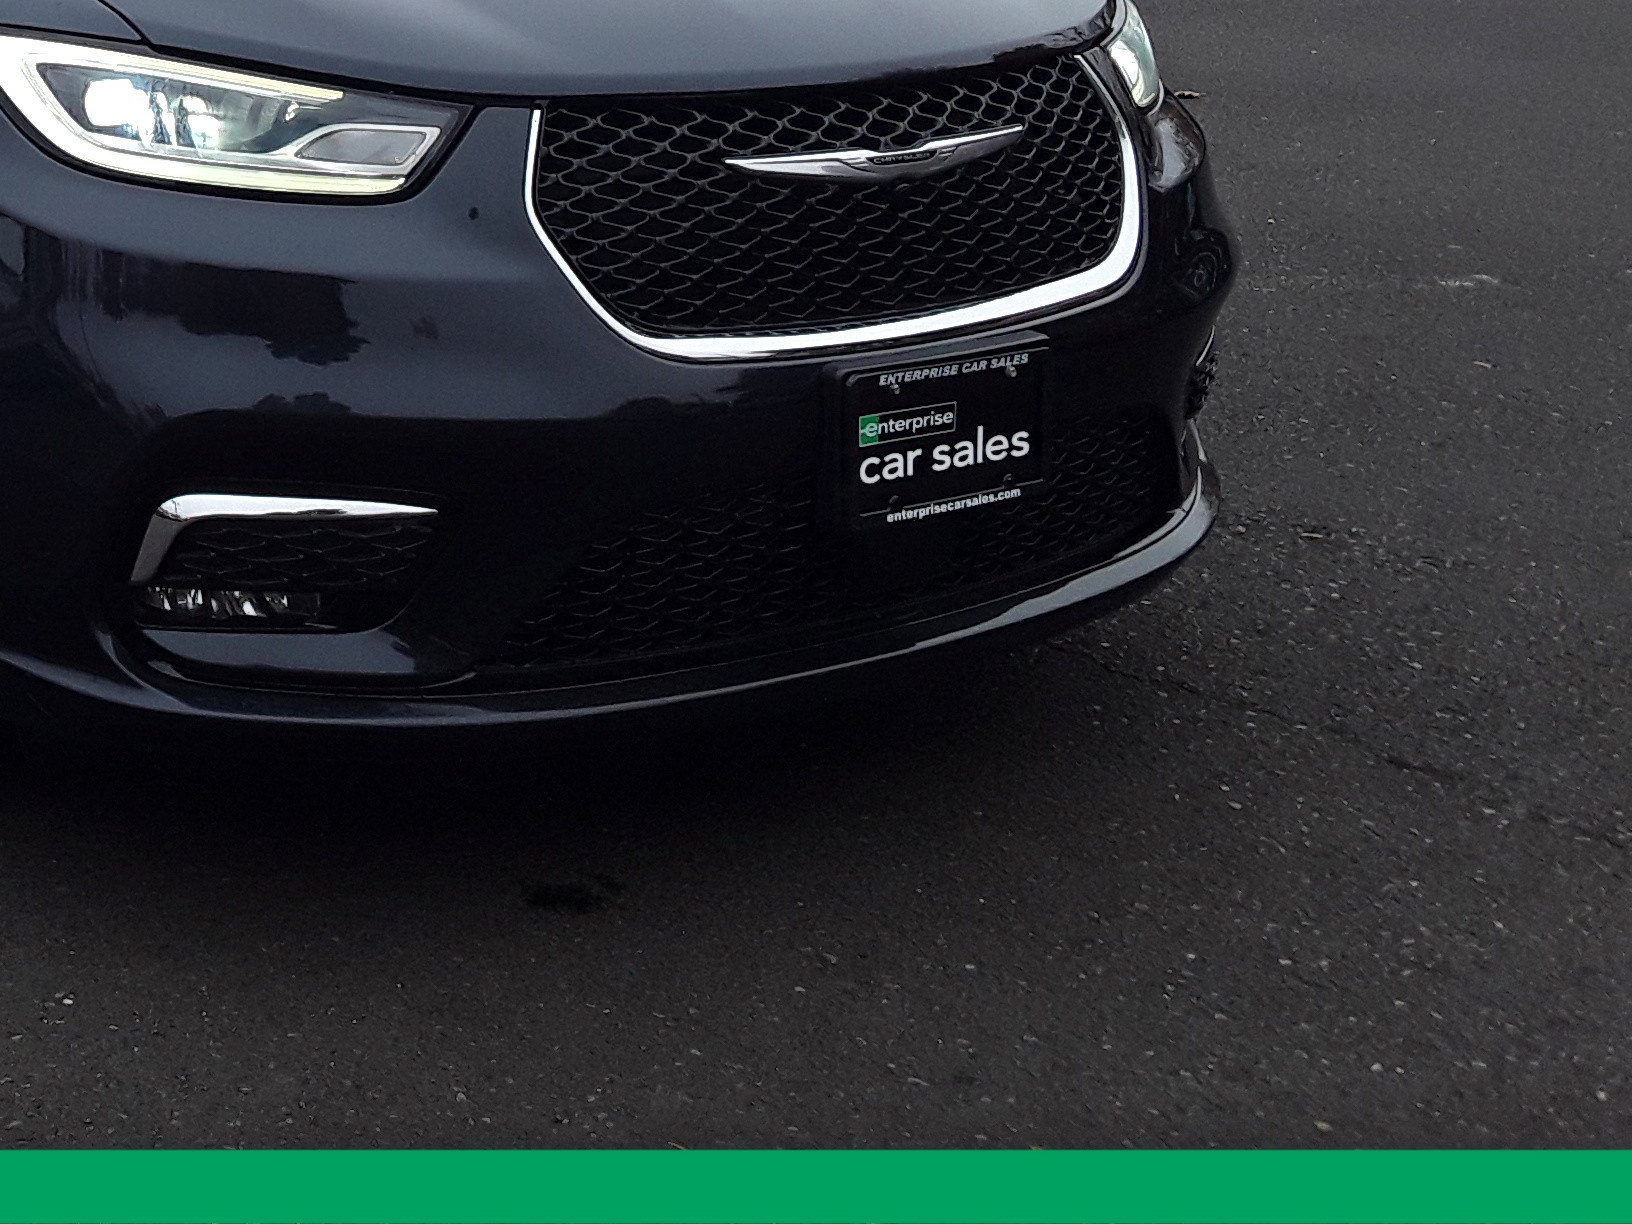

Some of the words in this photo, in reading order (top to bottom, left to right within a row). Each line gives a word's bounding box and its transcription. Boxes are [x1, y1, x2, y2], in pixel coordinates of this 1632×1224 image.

[879, 363, 959, 387] ENTERPRISE
[961, 359, 988, 375] CAR
[990, 352, 1030, 370] SALES
[862, 410, 954, 437] enterprise
[859, 447, 924, 485] car
[931, 424, 1031, 472] sales
[886, 487, 1022, 523] enterprisecarsales.com
